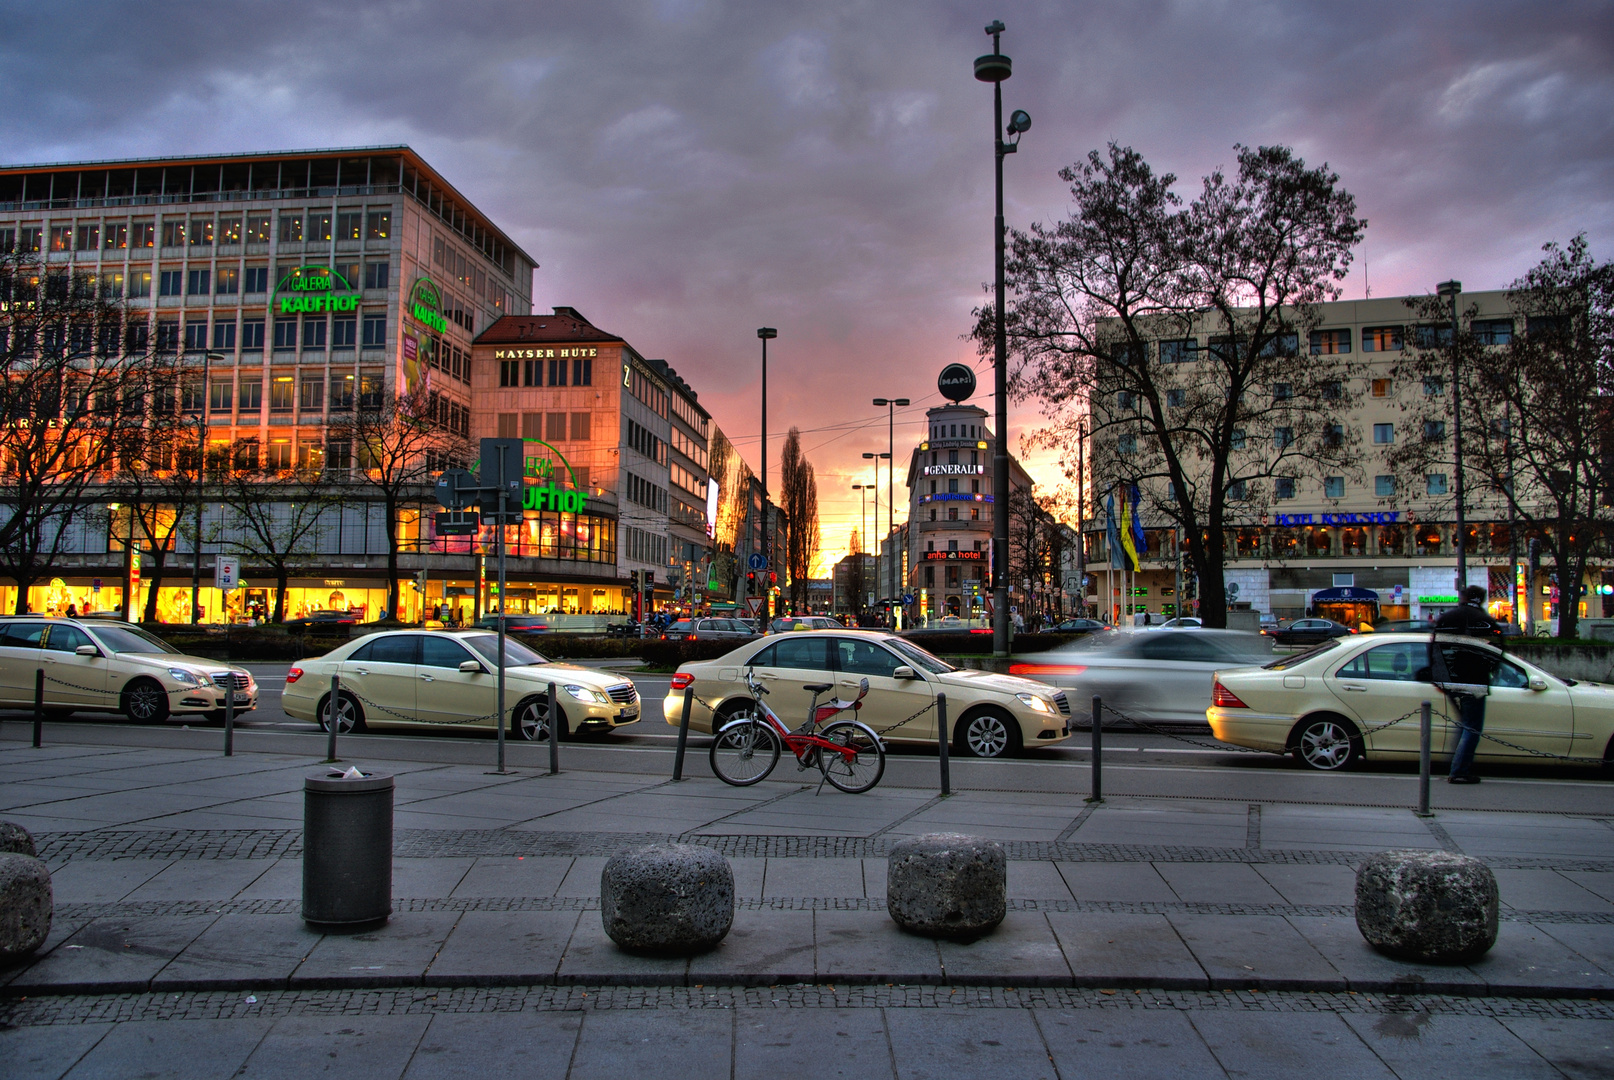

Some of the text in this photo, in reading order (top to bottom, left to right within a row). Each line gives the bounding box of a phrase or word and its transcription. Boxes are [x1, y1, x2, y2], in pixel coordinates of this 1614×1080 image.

[291, 276, 331, 291] GALERIA
[495, 347, 598, 359] MAYSER HÜTE
[623, 364, 630, 388] Z
[523, 456, 555, 478] ERIA
[929, 464, 977, 475] GENERALI
[1274, 513, 1317, 528] HOTEL
[958, 551, 981, 559] hotel
[132, 557, 140, 569] S
